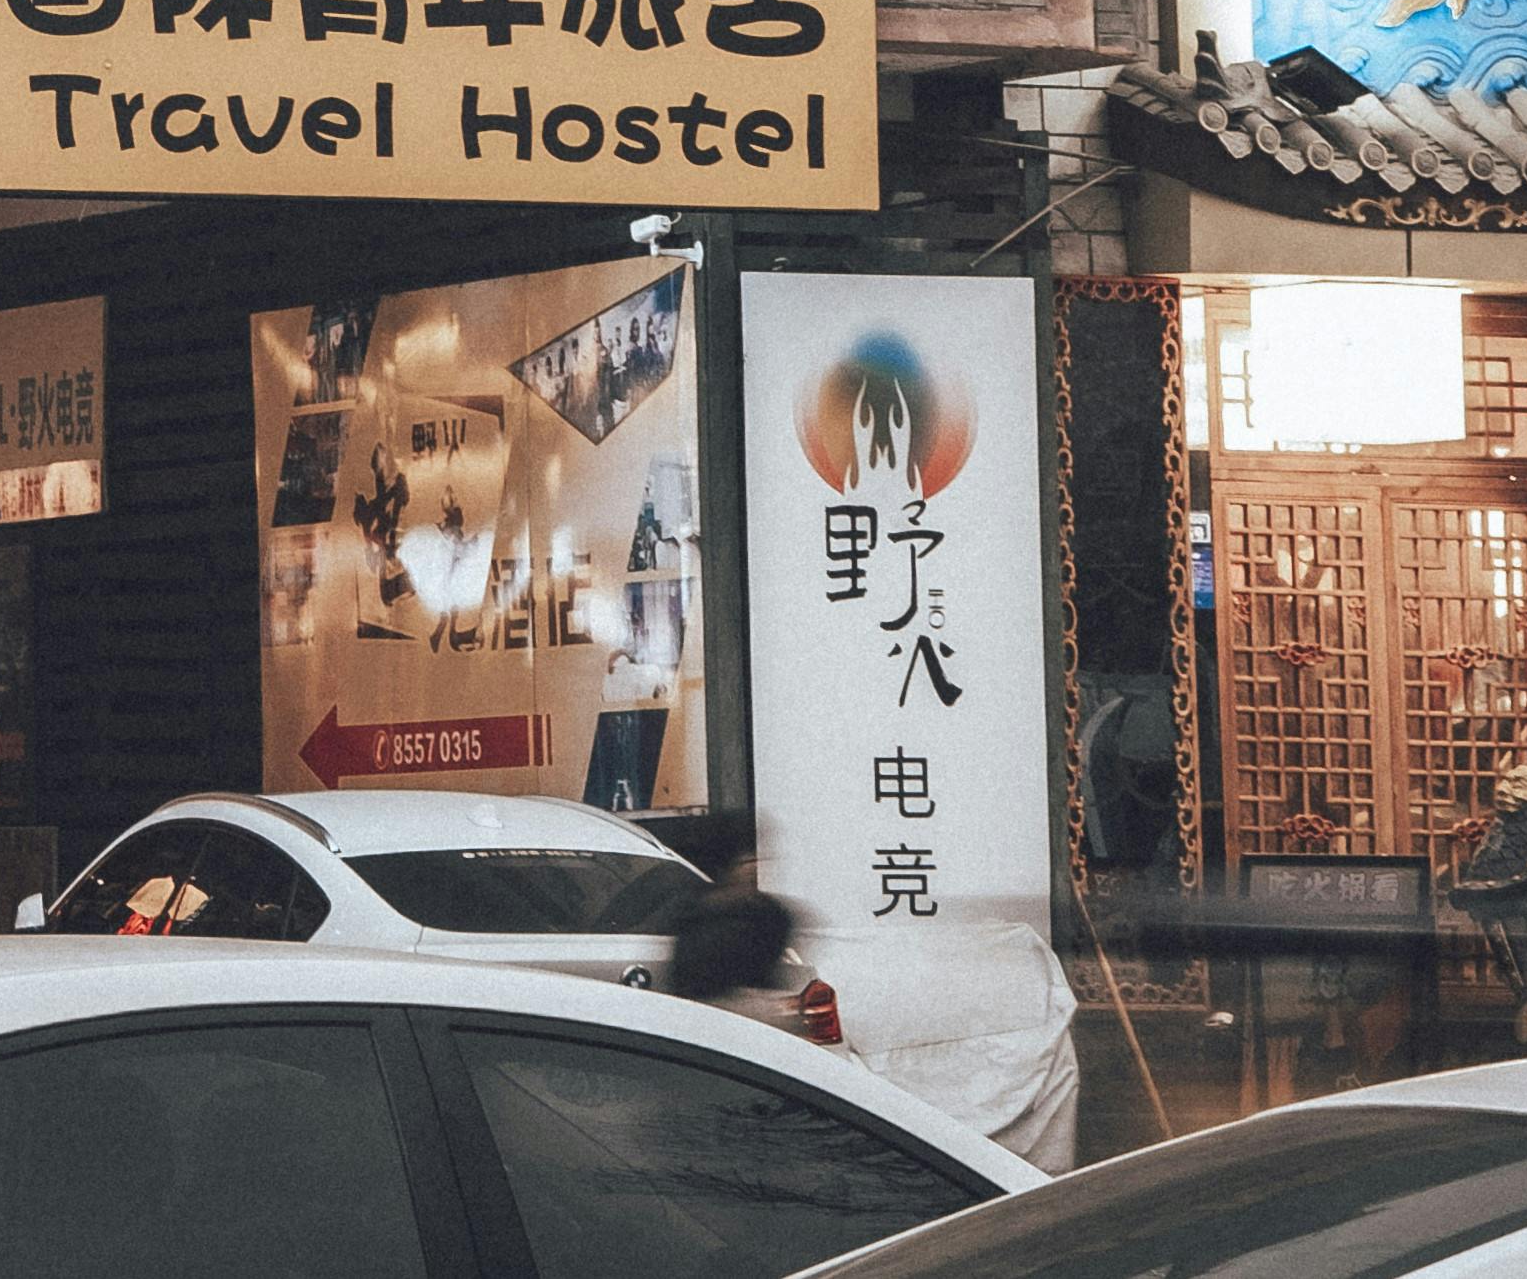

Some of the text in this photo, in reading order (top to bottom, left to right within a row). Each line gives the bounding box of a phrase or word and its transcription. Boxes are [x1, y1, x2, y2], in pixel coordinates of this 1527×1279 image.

[28, 75, 395, 158] Travel
[466, 84, 826, 168] Hostel
[825, 500, 962, 707] 野火
[873, 746, 939, 918] 电竞
